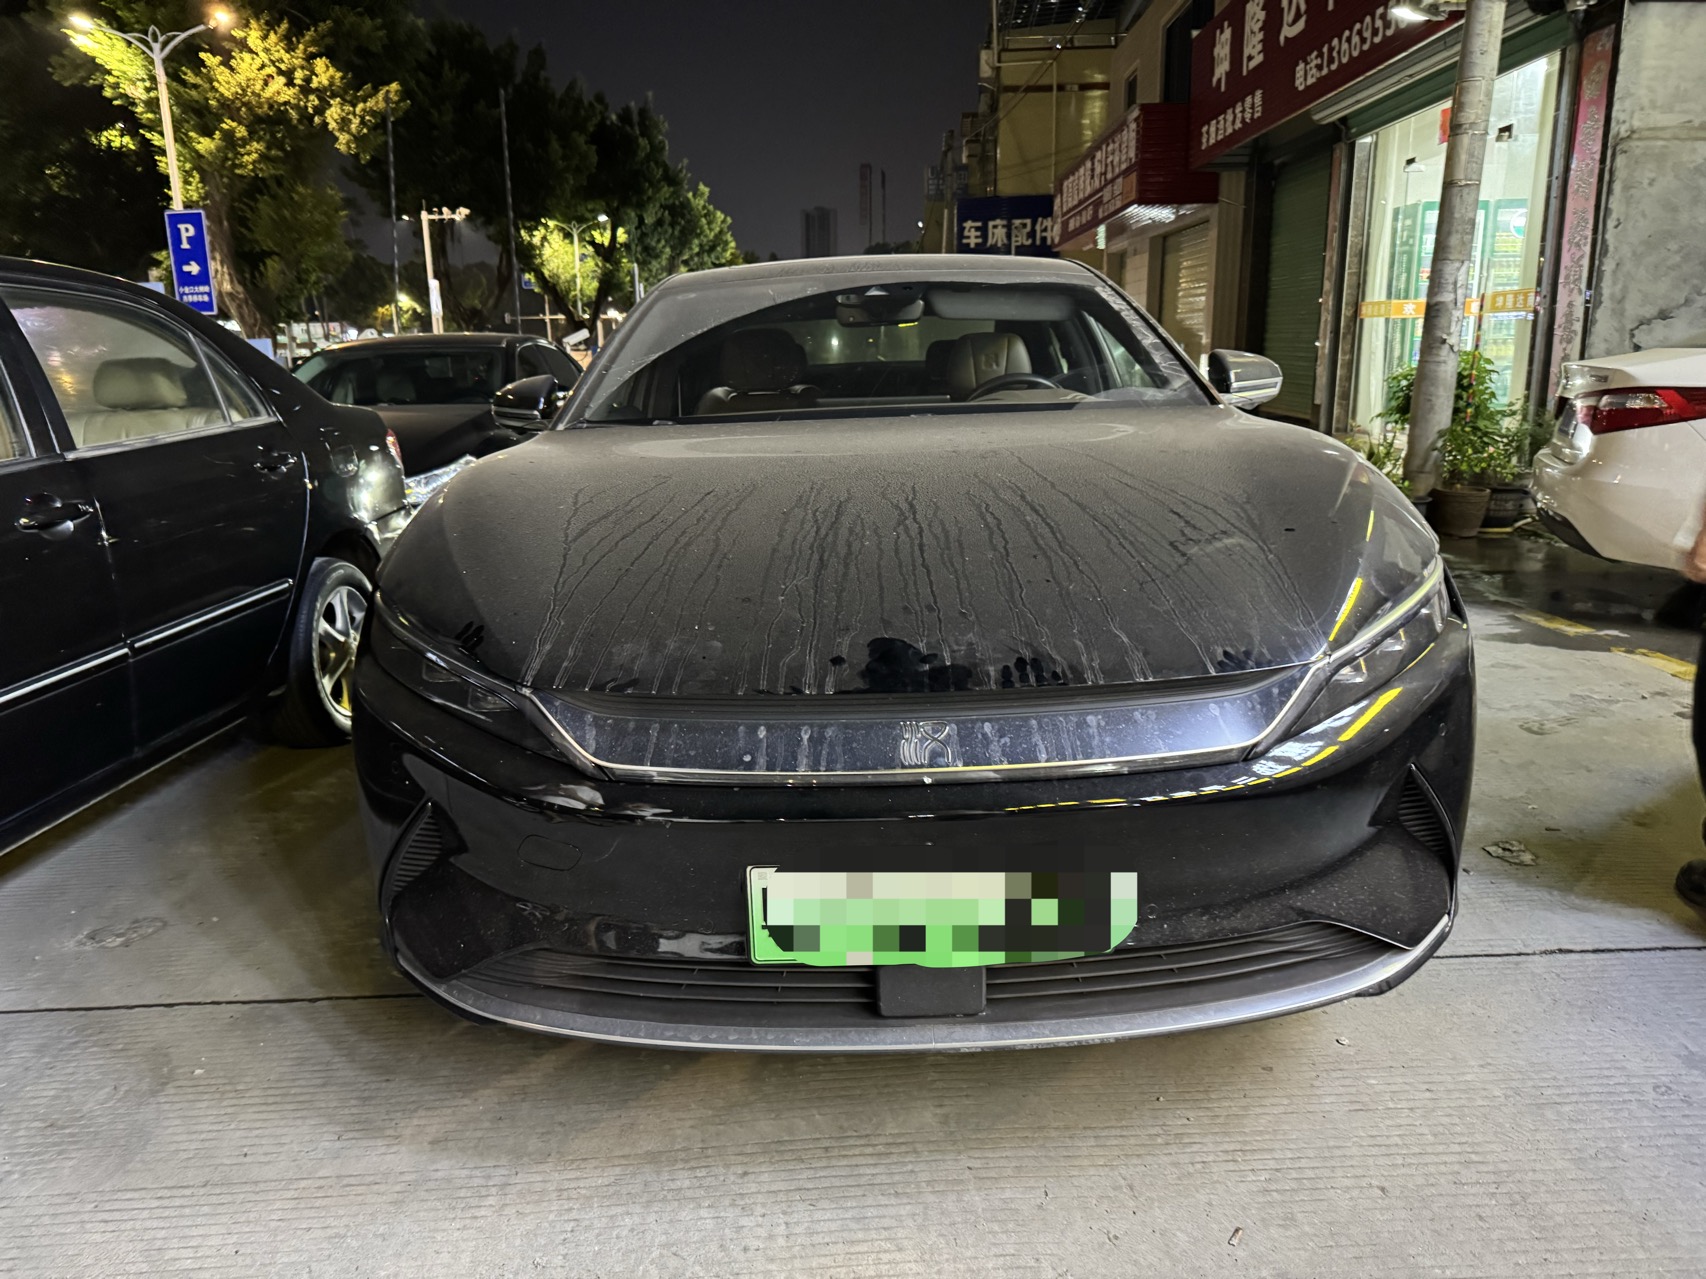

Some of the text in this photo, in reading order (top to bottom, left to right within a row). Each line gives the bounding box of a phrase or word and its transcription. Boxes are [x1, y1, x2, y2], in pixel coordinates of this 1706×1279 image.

[1211, 0, 1335, 92] 坤隆达
[177, 223, 195, 249] P
[962, 217, 1053, 250] 车床配件
